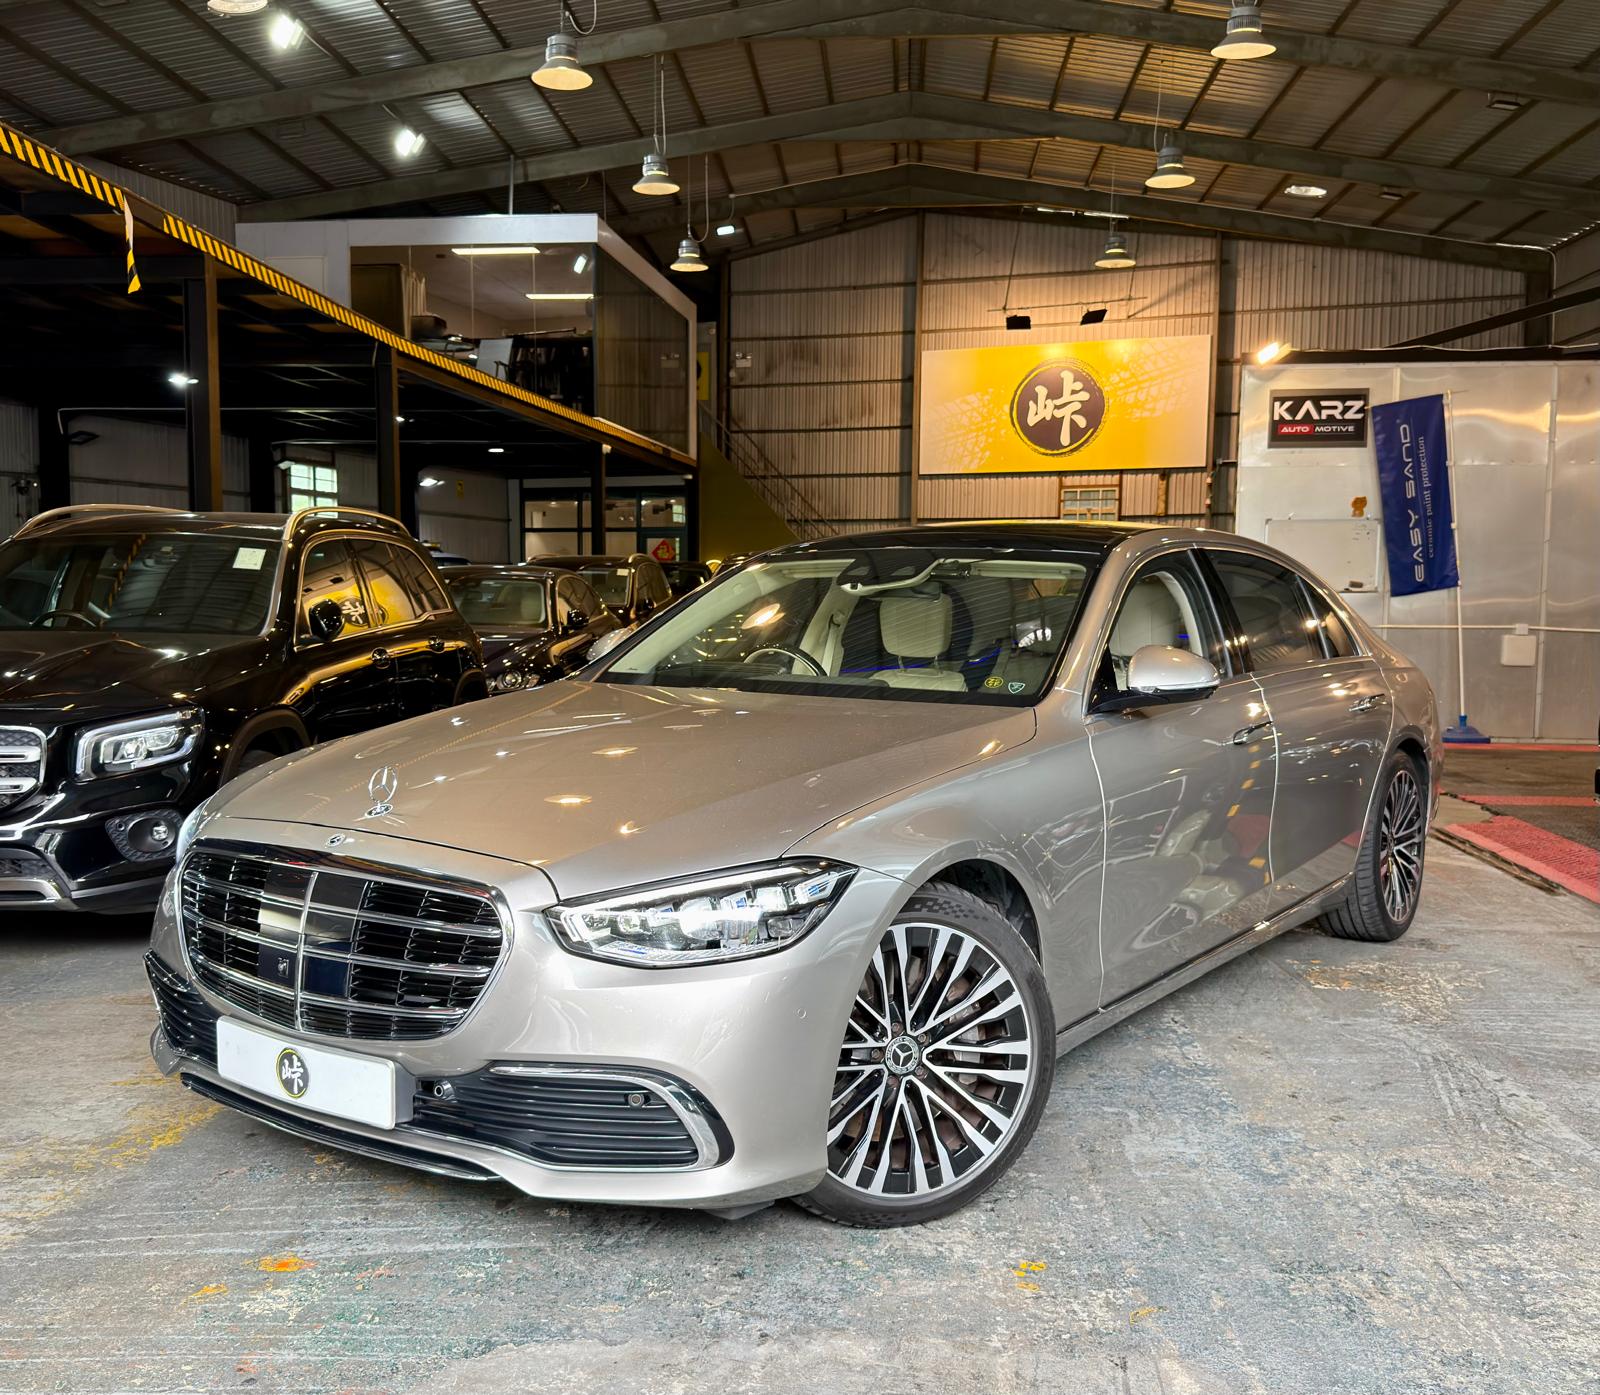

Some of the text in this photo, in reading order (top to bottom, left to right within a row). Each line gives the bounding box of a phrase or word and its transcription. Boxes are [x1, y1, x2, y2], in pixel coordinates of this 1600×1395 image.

[1027, 370, 1090, 446] 峠
[1273, 400, 1364, 420] KARZ
[1314, 425, 1355, 433] MOTIVE
[1400, 424, 1425, 582] EASY SAND
[1418, 436, 1434, 558] ceramic paint protection
[282, 1054, 304, 1094] 峠
